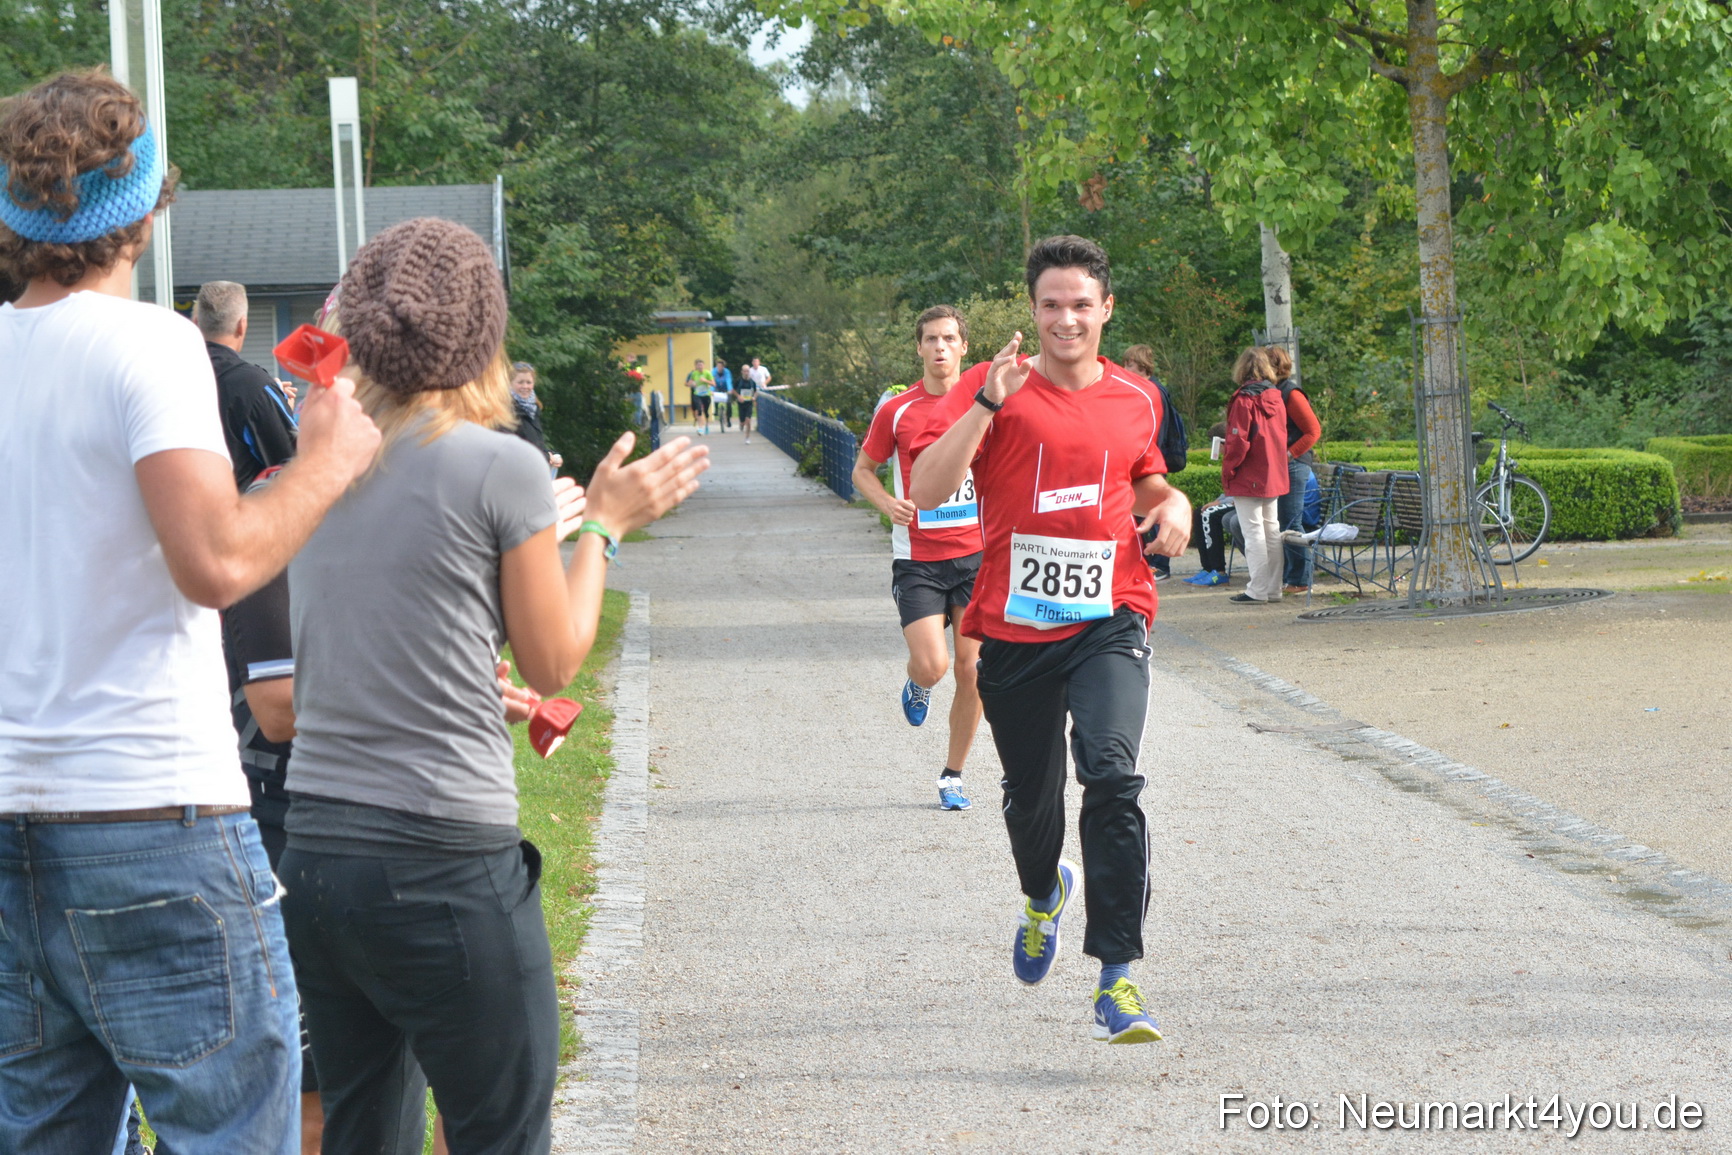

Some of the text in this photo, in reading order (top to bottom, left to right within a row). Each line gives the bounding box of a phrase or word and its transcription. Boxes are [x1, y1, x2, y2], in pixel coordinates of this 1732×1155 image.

[1055, 492, 1082, 504] DEHN
[935, 510, 967, 519] Thomas
[1013, 542, 1098, 559] PARTL Neumarkt
[1020, 557, 1103, 598] 2853
[1035, 604, 1082, 621] Florian
